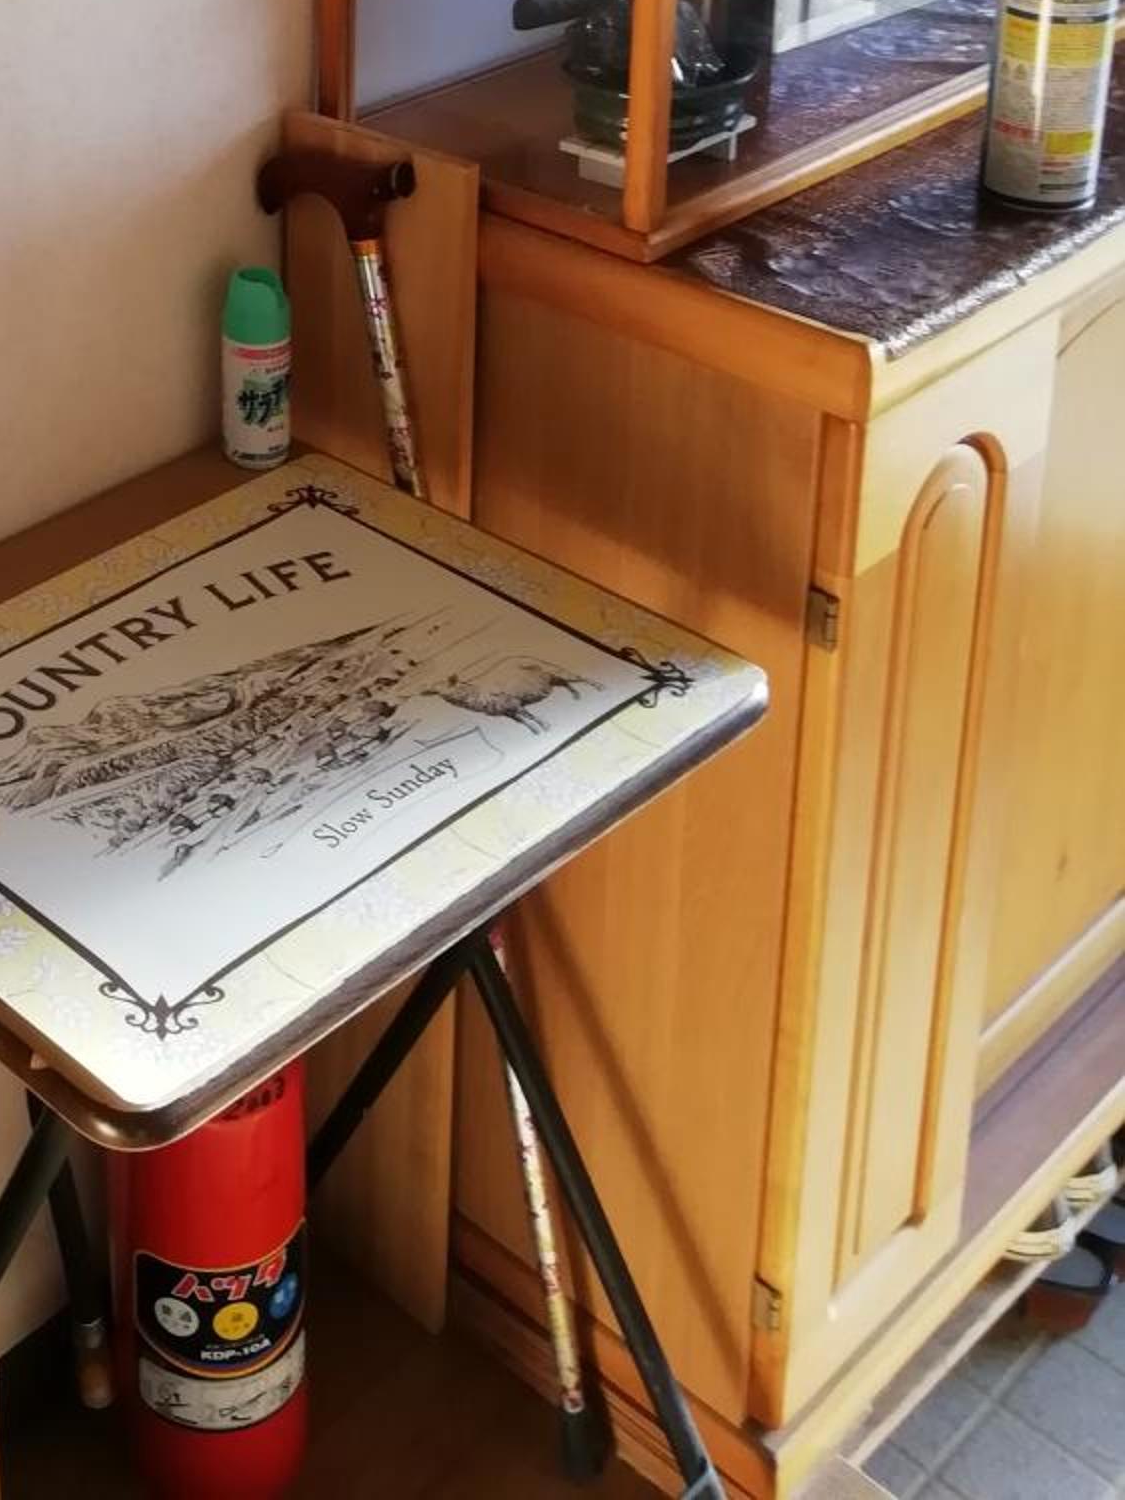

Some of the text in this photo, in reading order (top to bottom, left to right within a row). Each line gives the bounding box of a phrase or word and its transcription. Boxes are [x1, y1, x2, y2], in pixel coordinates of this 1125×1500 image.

[203, 551, 351, 611] LIFE
[313, 759, 458, 848] Slow Sunday
